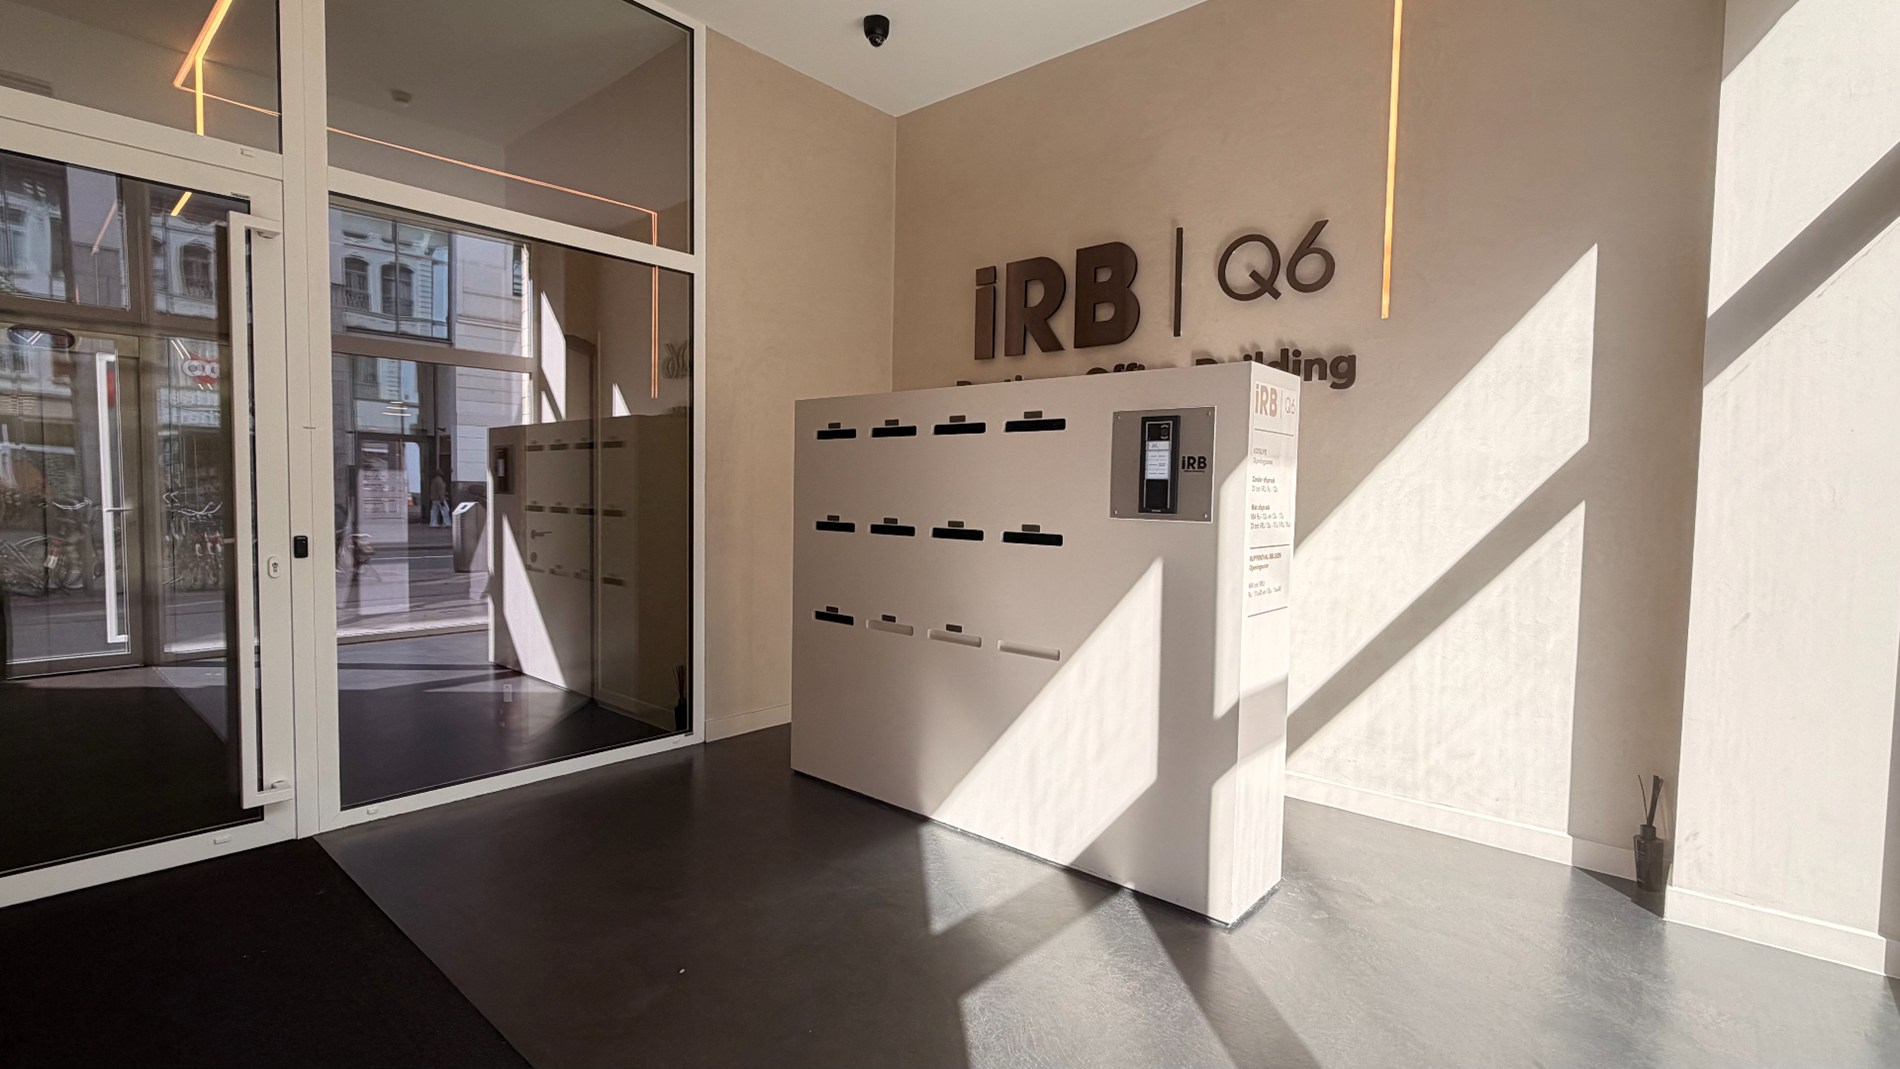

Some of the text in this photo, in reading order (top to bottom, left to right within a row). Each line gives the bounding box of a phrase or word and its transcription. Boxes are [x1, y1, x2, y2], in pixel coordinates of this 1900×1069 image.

[974, 219, 1336, 360] iRB Q6
[1254, 384, 1278, 418] iRB
[1181, 456, 1207, 470] iRB
